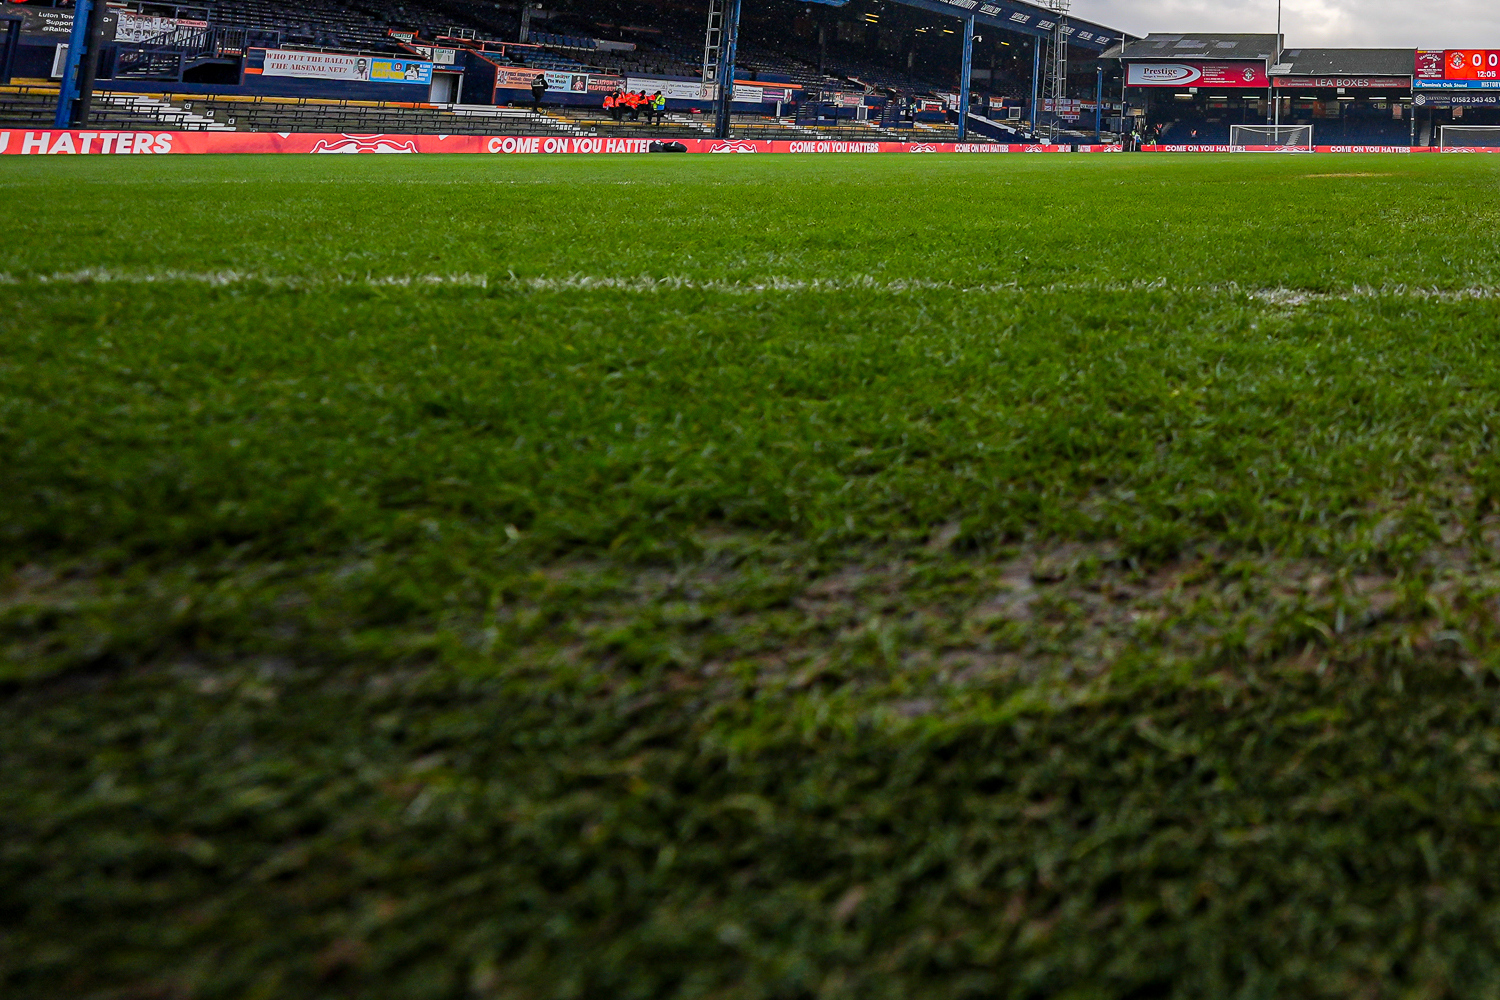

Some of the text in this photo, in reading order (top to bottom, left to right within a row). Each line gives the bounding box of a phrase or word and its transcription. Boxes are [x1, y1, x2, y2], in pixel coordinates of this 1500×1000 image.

[58, 12, 75, 20] Tow
[266, 52, 287, 61] WHO
[288, 54, 301, 62] PUT
[302, 54, 322, 62] THE
[324, 56, 343, 64] BALL
[1472, 54, 1498, 66] 0 0
[290, 64, 327, 72] ARSENAL
[1144, 67, 1178, 77] Prestige
[21, 132, 172, 154] HATTERS
[488, 137, 540, 154] COME
[544, 138, 568, 154] ON
[572, 138, 602, 154] YOU
[790, 142, 879, 153] COME ON YOU HATTERS
[955, 144, 1009, 152] COME ON YOU HATTERS
